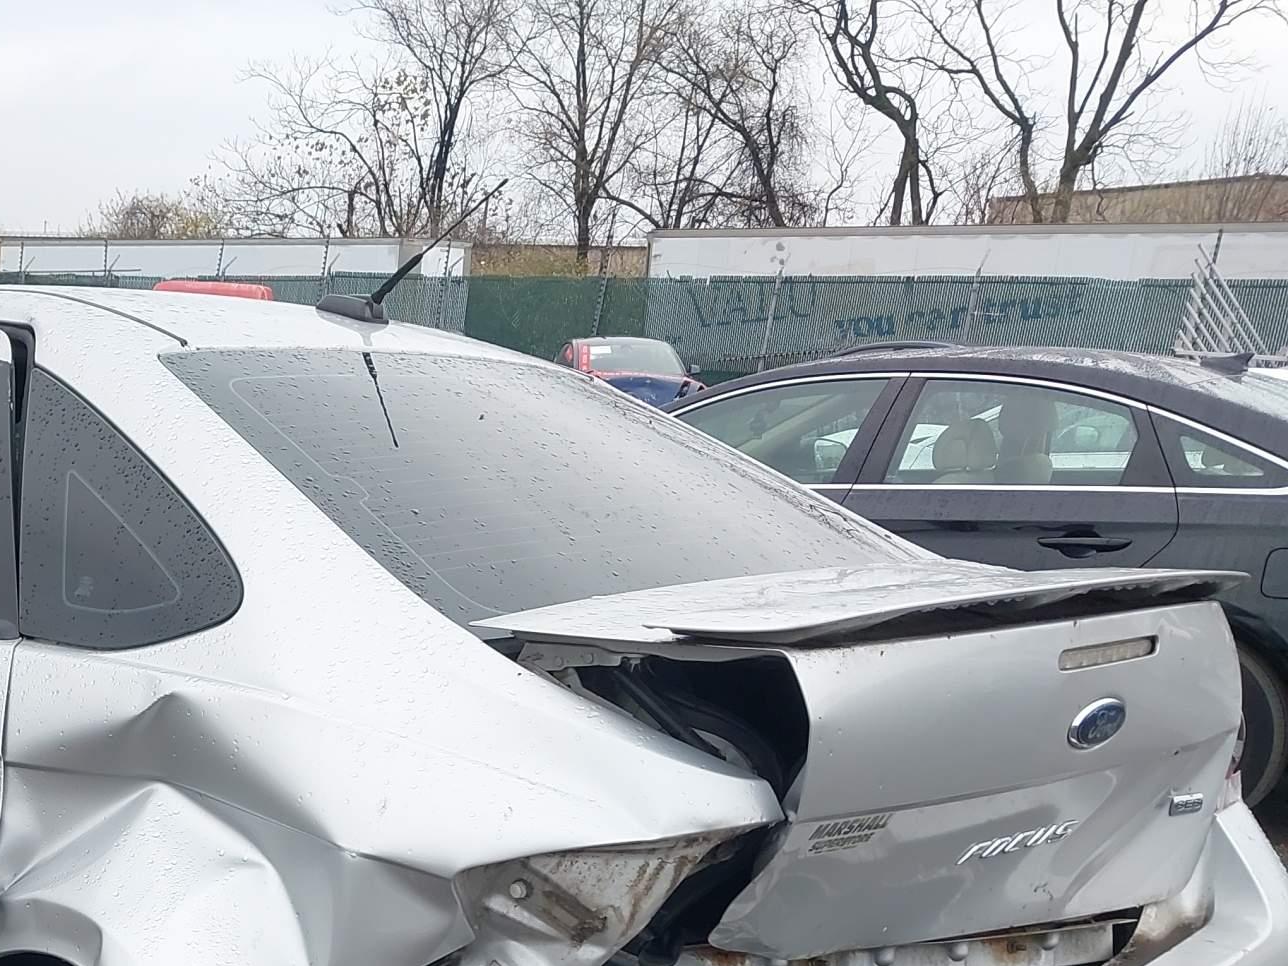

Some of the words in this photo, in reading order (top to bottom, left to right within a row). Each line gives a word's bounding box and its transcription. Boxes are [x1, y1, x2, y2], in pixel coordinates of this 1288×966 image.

[833, 313, 896, 341] you
[808, 814, 893, 841] MARSHALL
[955, 819, 1080, 866] FOCUS
